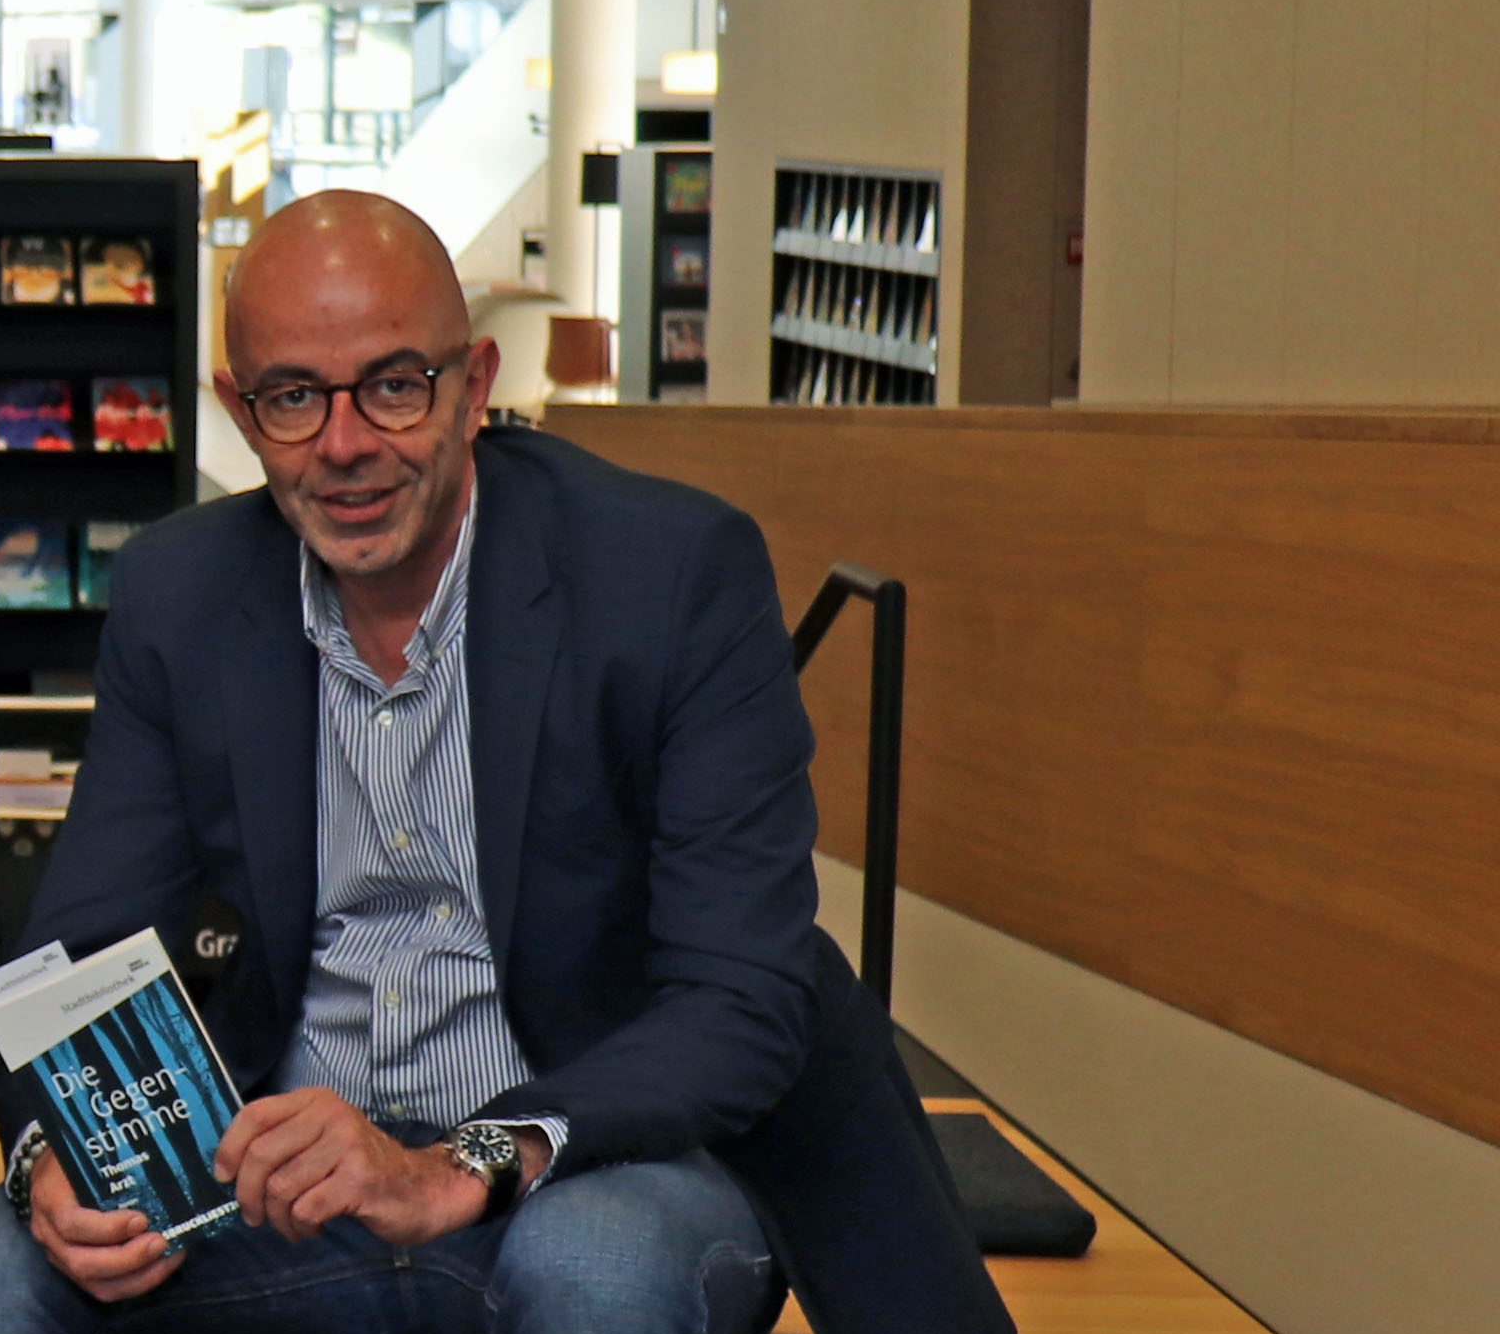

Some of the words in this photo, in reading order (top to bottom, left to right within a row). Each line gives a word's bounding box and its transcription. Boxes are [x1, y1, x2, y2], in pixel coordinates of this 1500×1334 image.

[51, 1064, 101, 1100] Die
[90, 1066, 188, 1120] Gegen-
[86, 1099, 193, 1161] stimme
